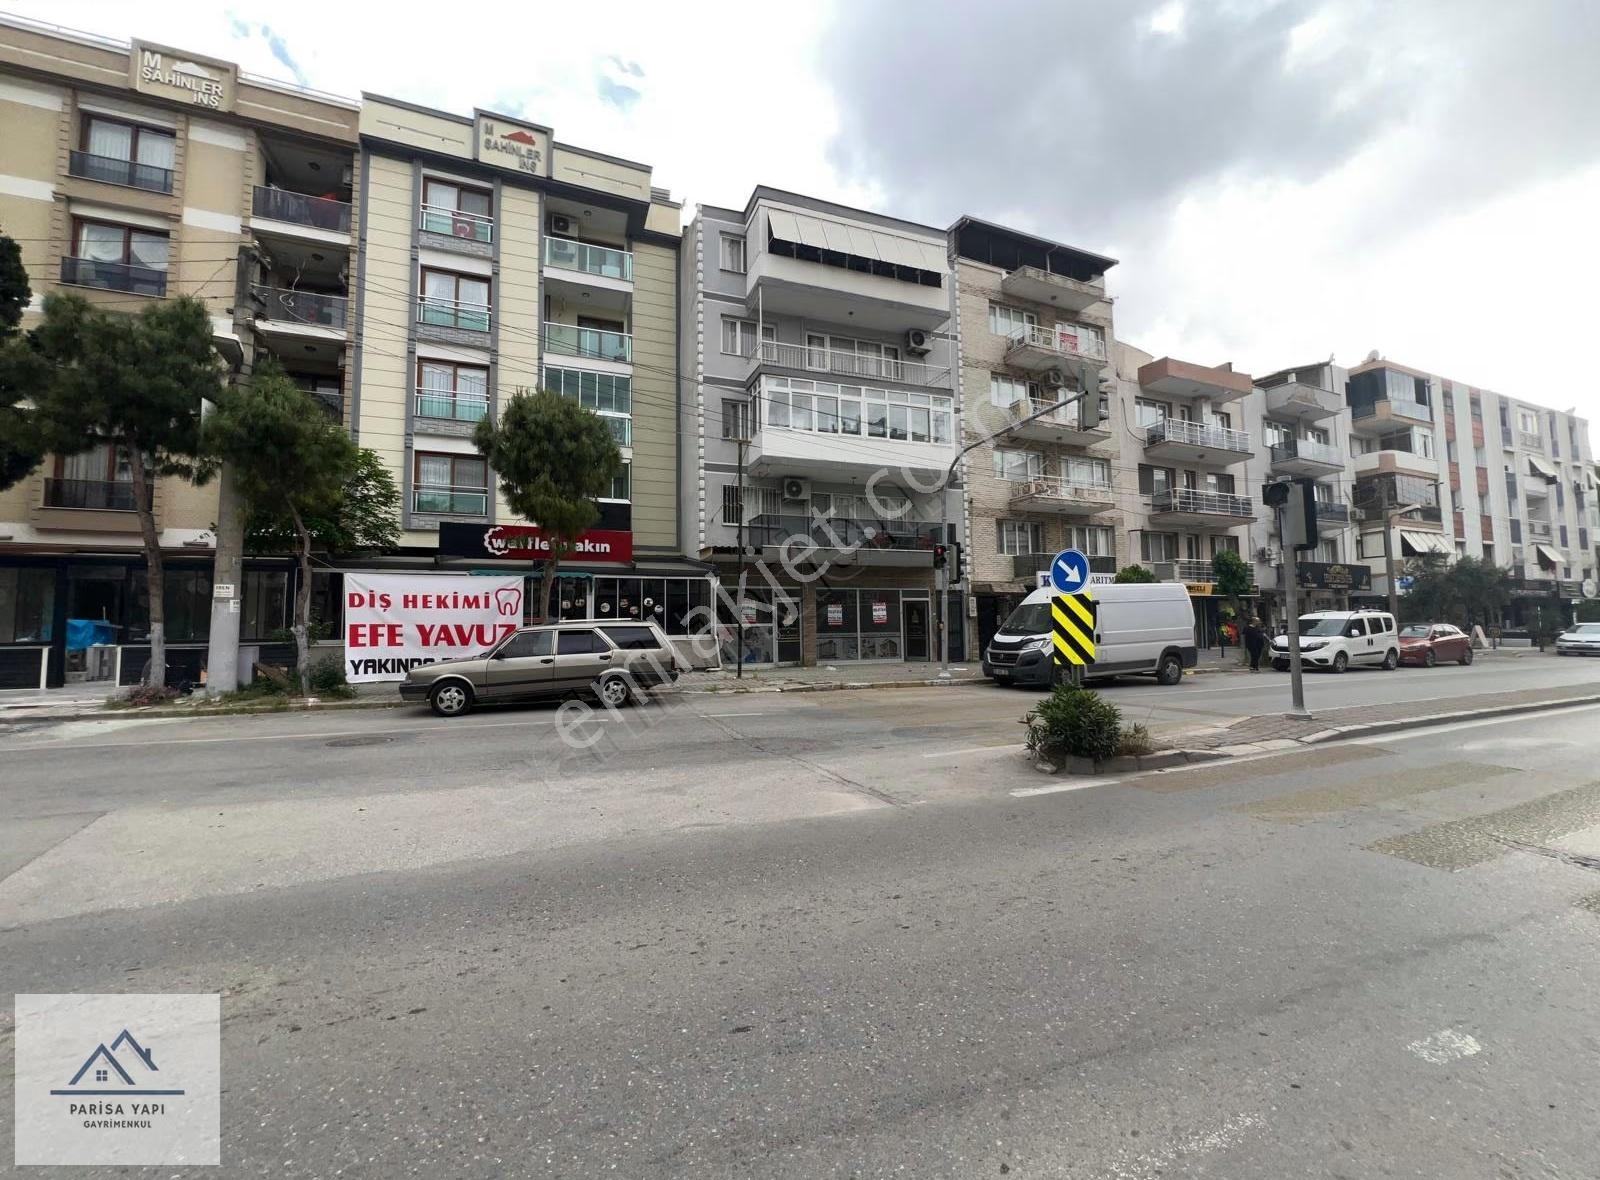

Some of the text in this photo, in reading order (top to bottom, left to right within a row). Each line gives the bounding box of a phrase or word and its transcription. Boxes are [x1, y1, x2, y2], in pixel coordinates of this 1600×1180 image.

[143, 50, 162, 70] M
[348, 590, 490, 612] DİŞ HEKİMİ
[348, 624, 517, 648] EFE YAVUZ
